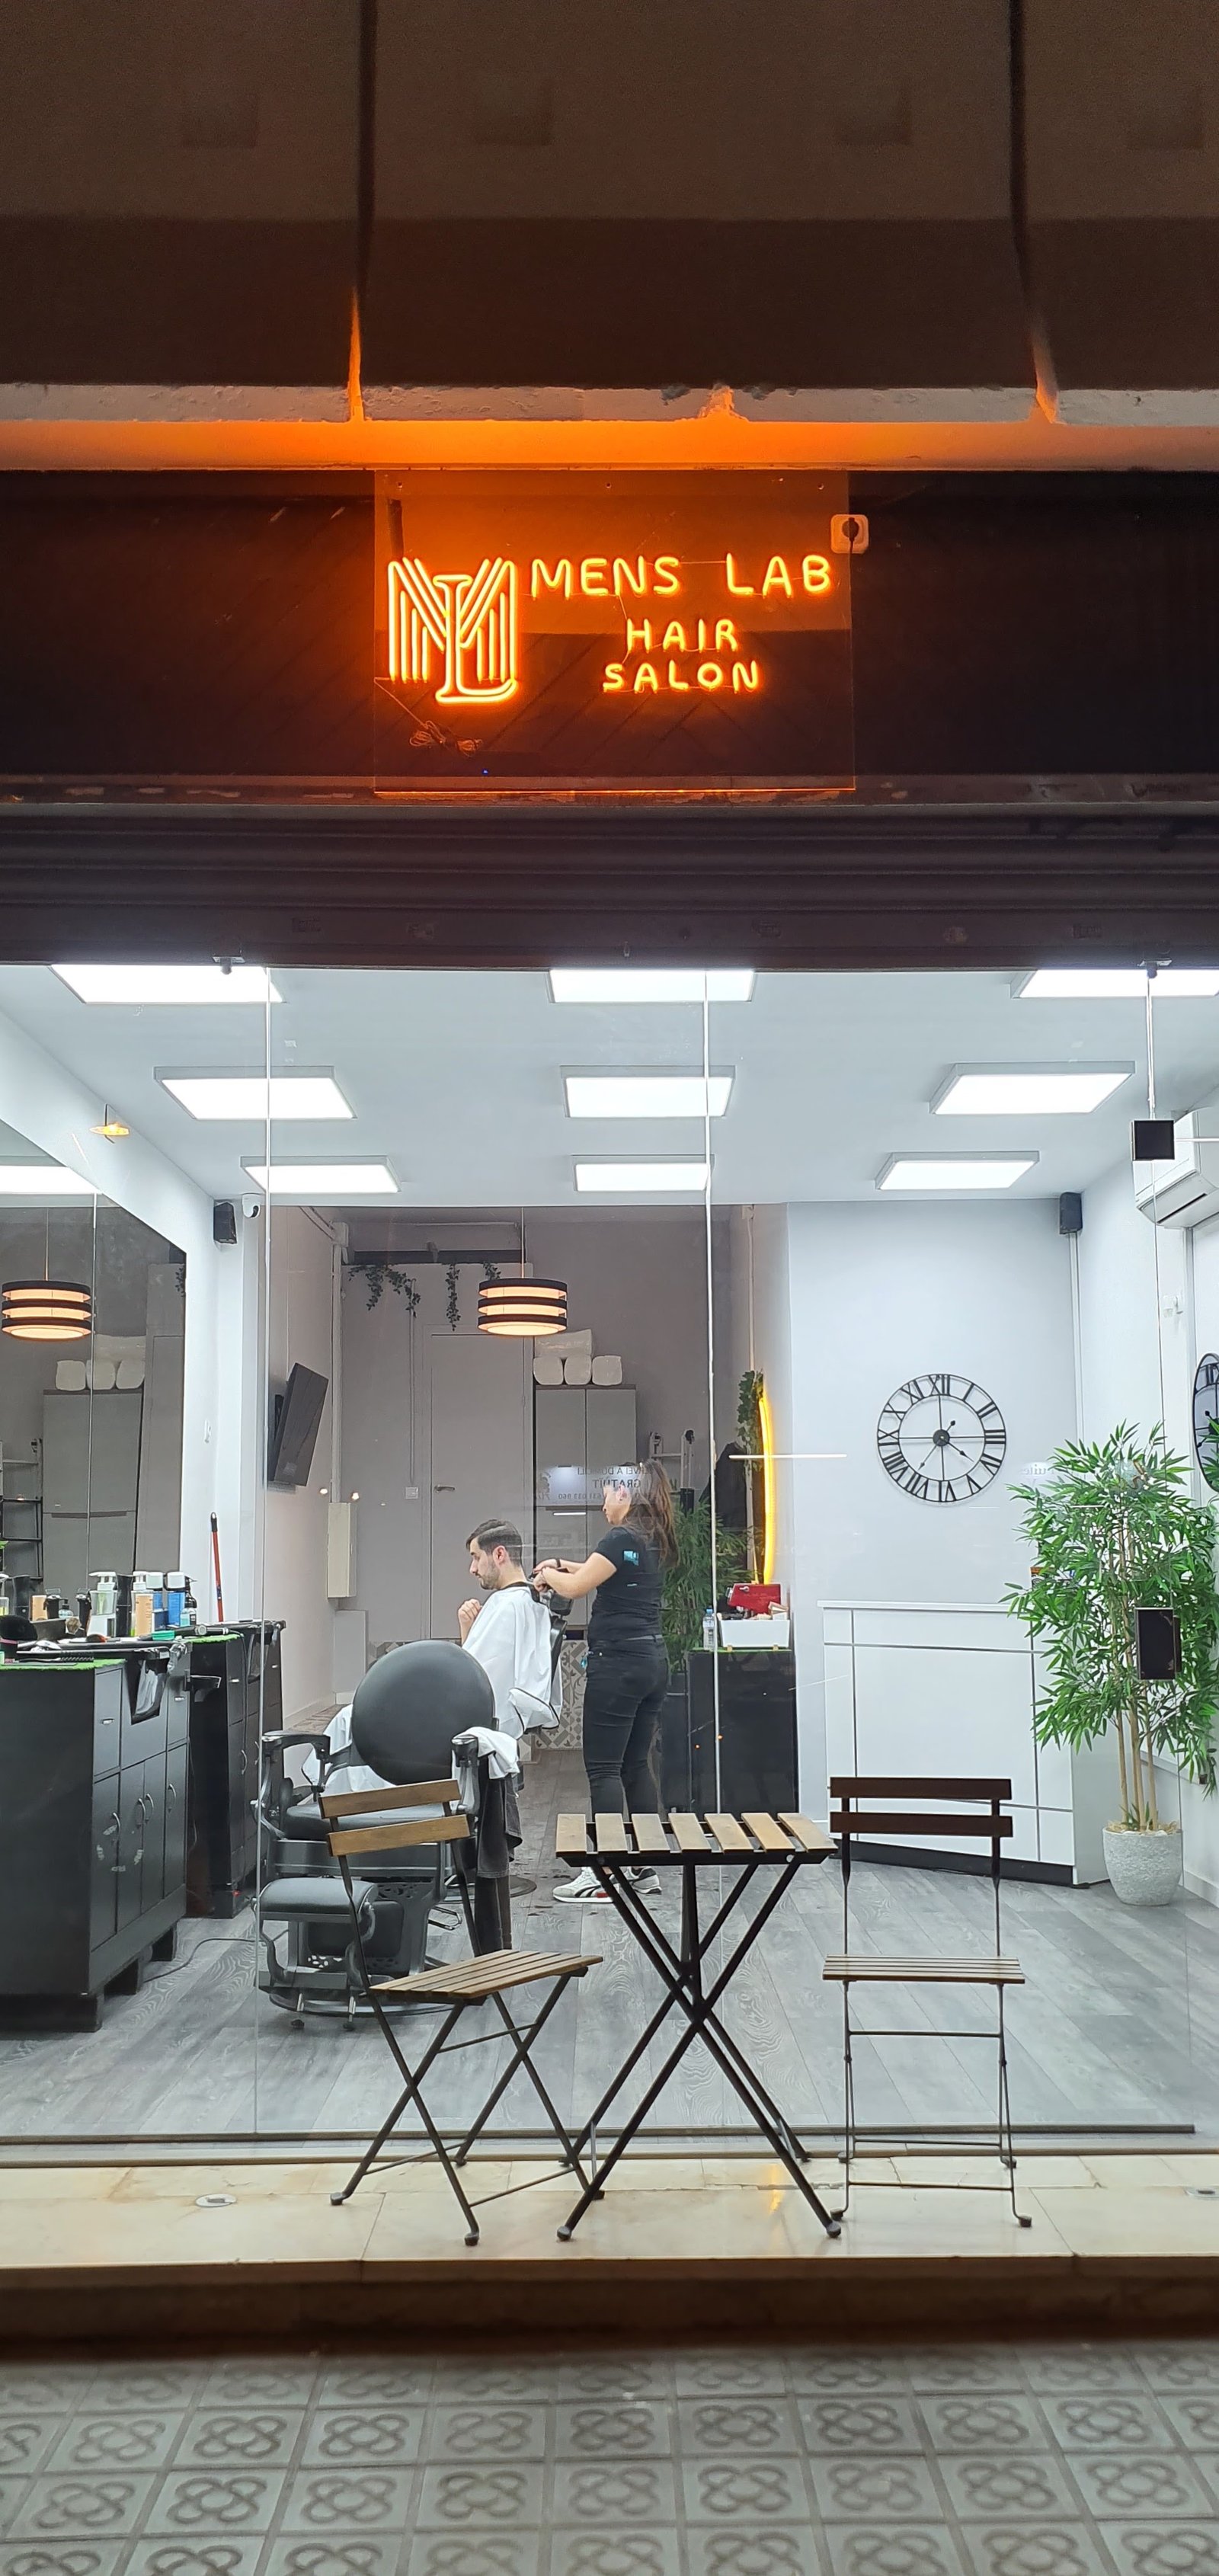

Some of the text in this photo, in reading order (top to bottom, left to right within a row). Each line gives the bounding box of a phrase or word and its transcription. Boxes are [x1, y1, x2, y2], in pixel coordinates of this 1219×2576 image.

[531, 552, 833, 600] MENS LAB
[625, 618, 738, 653] HAIR
[603, 660, 760, 694] SALON
